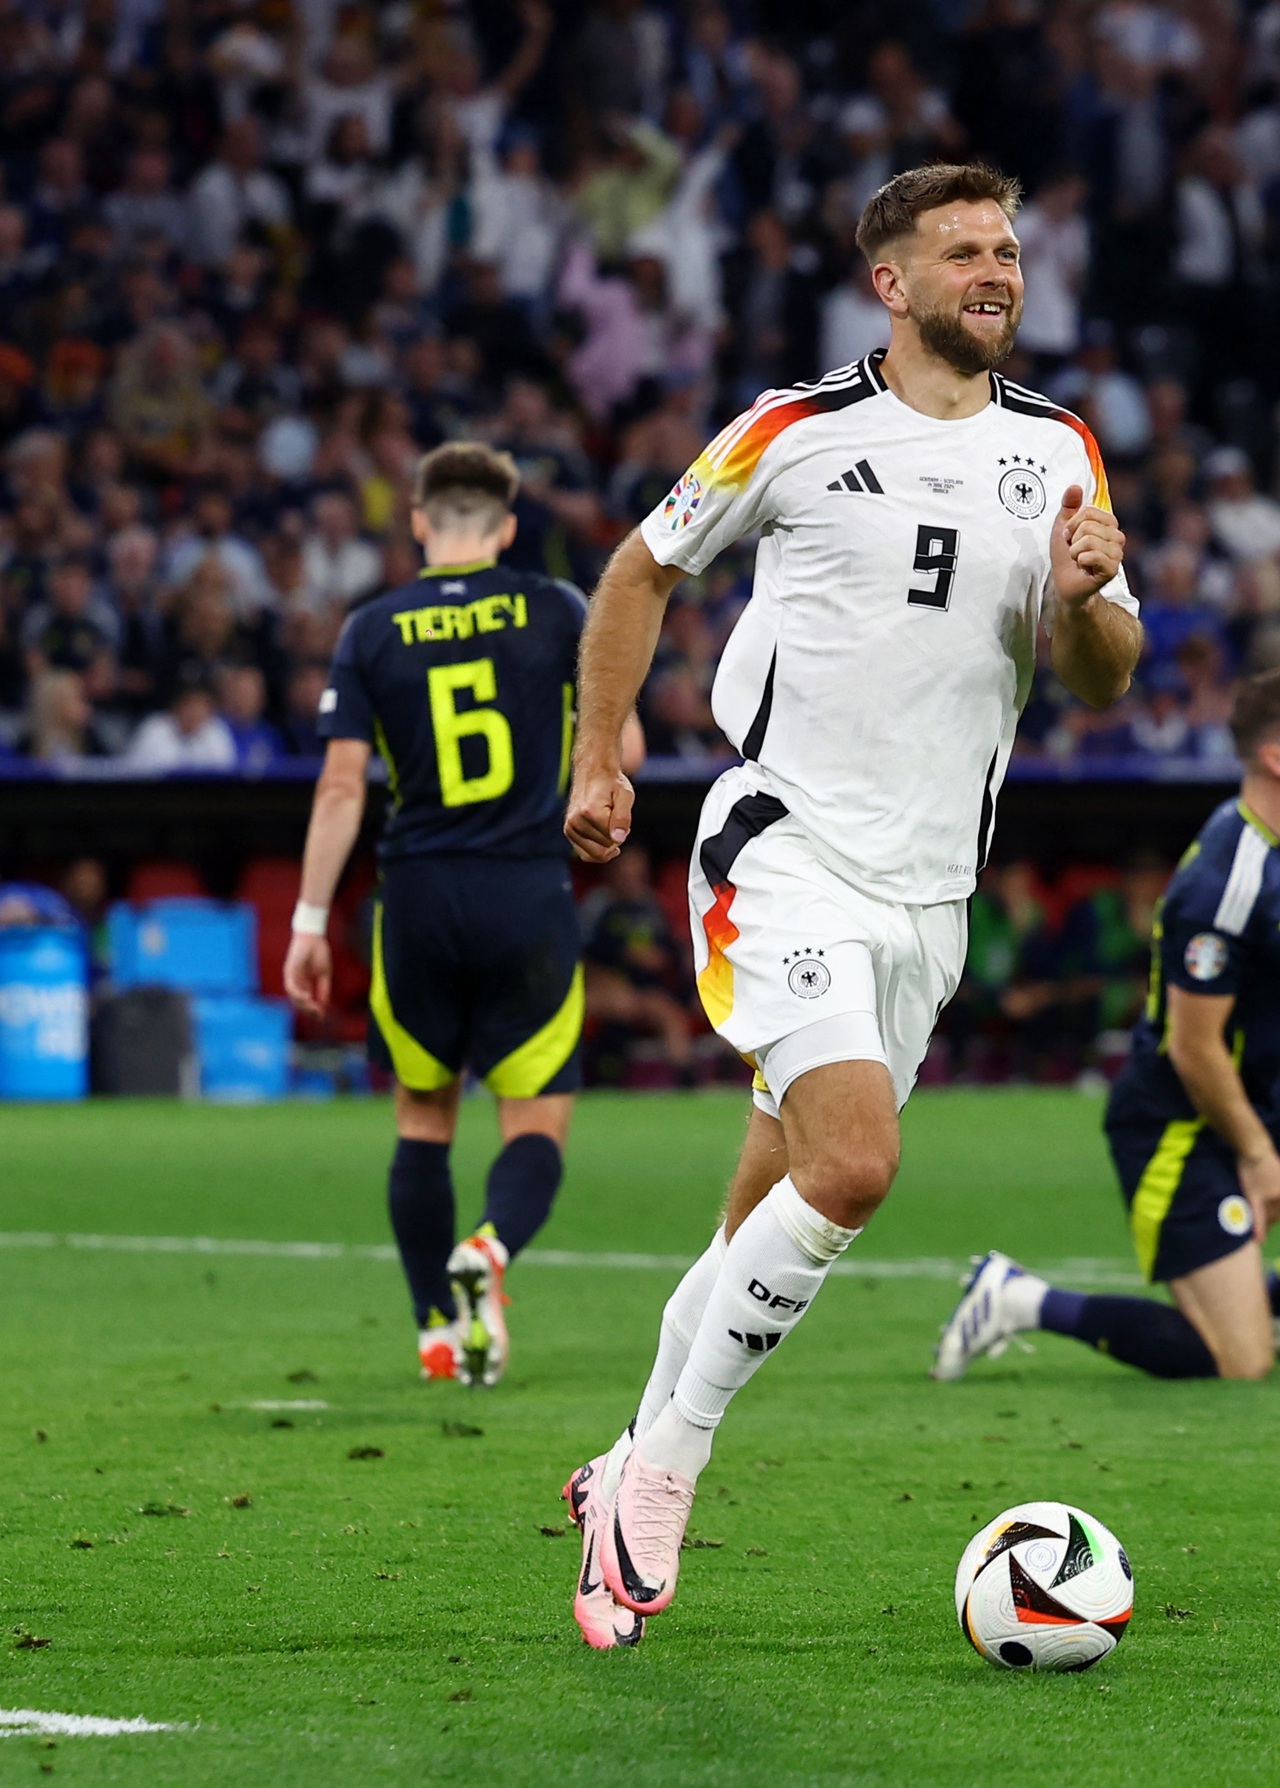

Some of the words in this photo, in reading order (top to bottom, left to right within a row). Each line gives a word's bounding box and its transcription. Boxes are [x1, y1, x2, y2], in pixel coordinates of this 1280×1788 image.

[907, 524, 960, 612] 9
[392, 593, 528, 646] TIERNEY
[427, 658, 515, 808] 6
[747, 1278, 809, 1313] DFB
